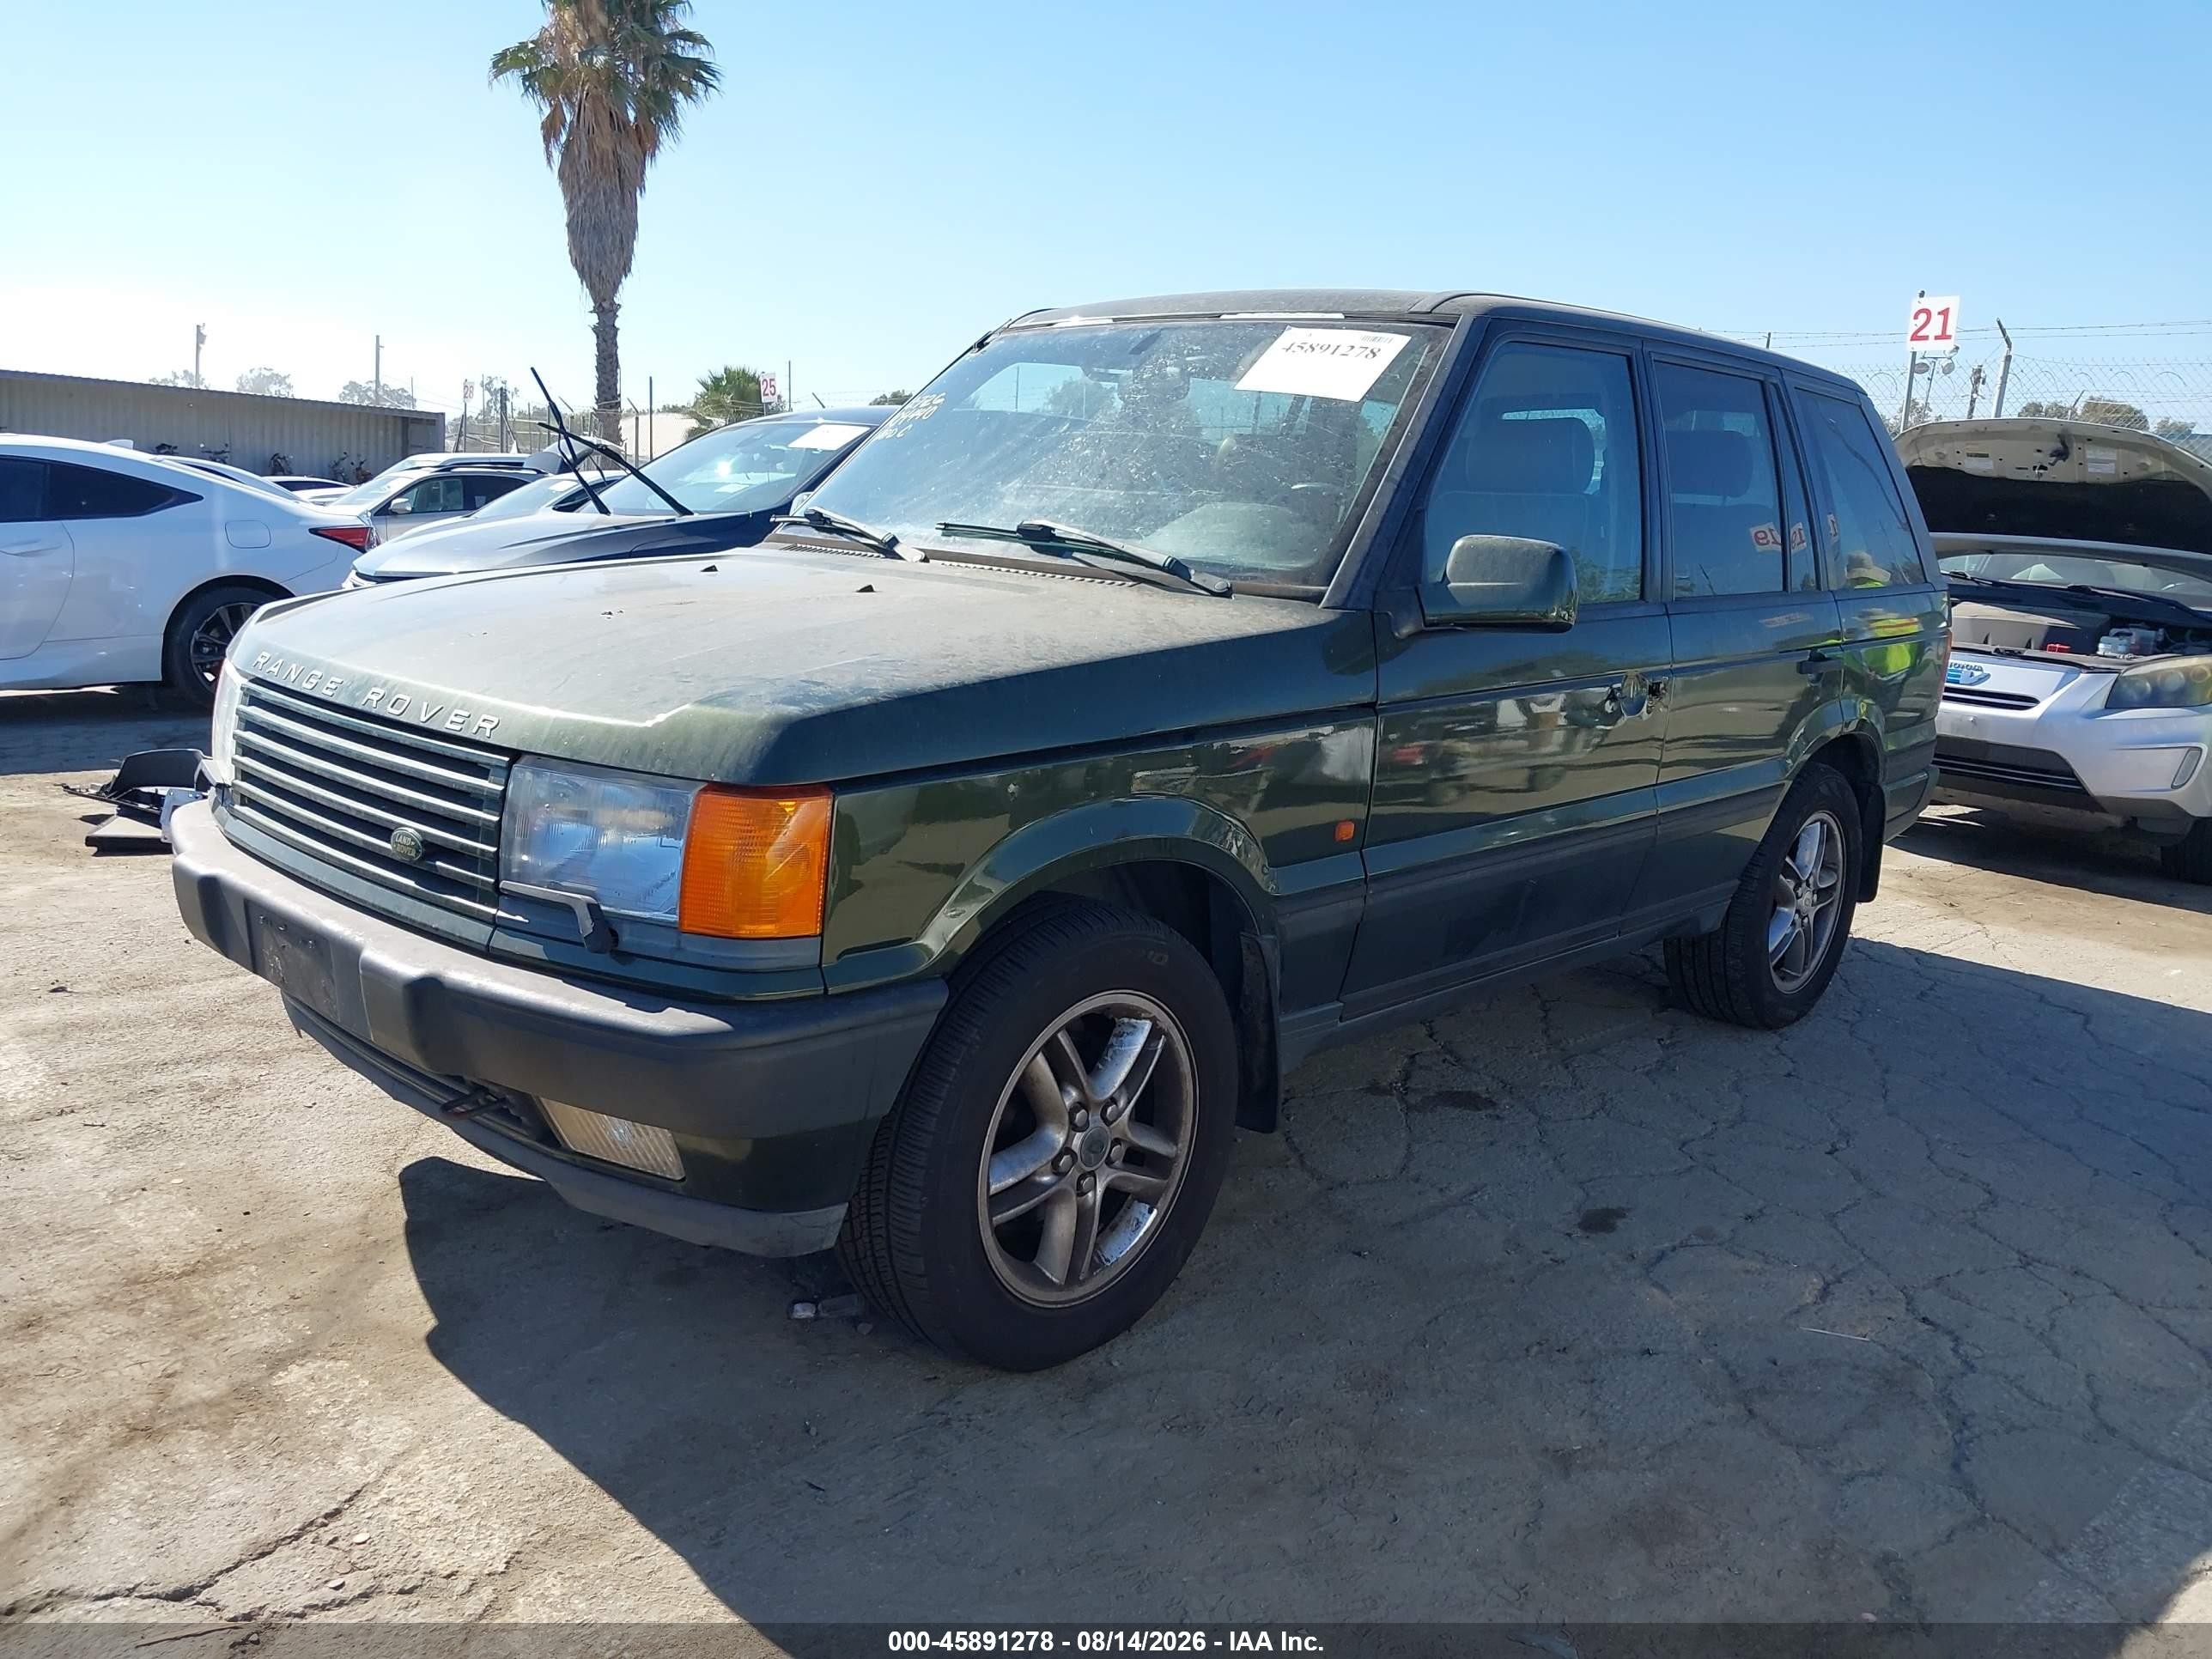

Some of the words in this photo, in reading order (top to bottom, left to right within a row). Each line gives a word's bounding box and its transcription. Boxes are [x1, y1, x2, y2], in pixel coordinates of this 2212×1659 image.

[1910, 307, 1953, 341] 21
[1282, 342, 1381, 360] 45891278
[464, 385, 474, 399] 28
[762, 378, 776, 397] 25
[252, 651, 344, 697] RANGE
[362, 686, 501, 738] ROVER
[396, 834, 411, 846] LAND
